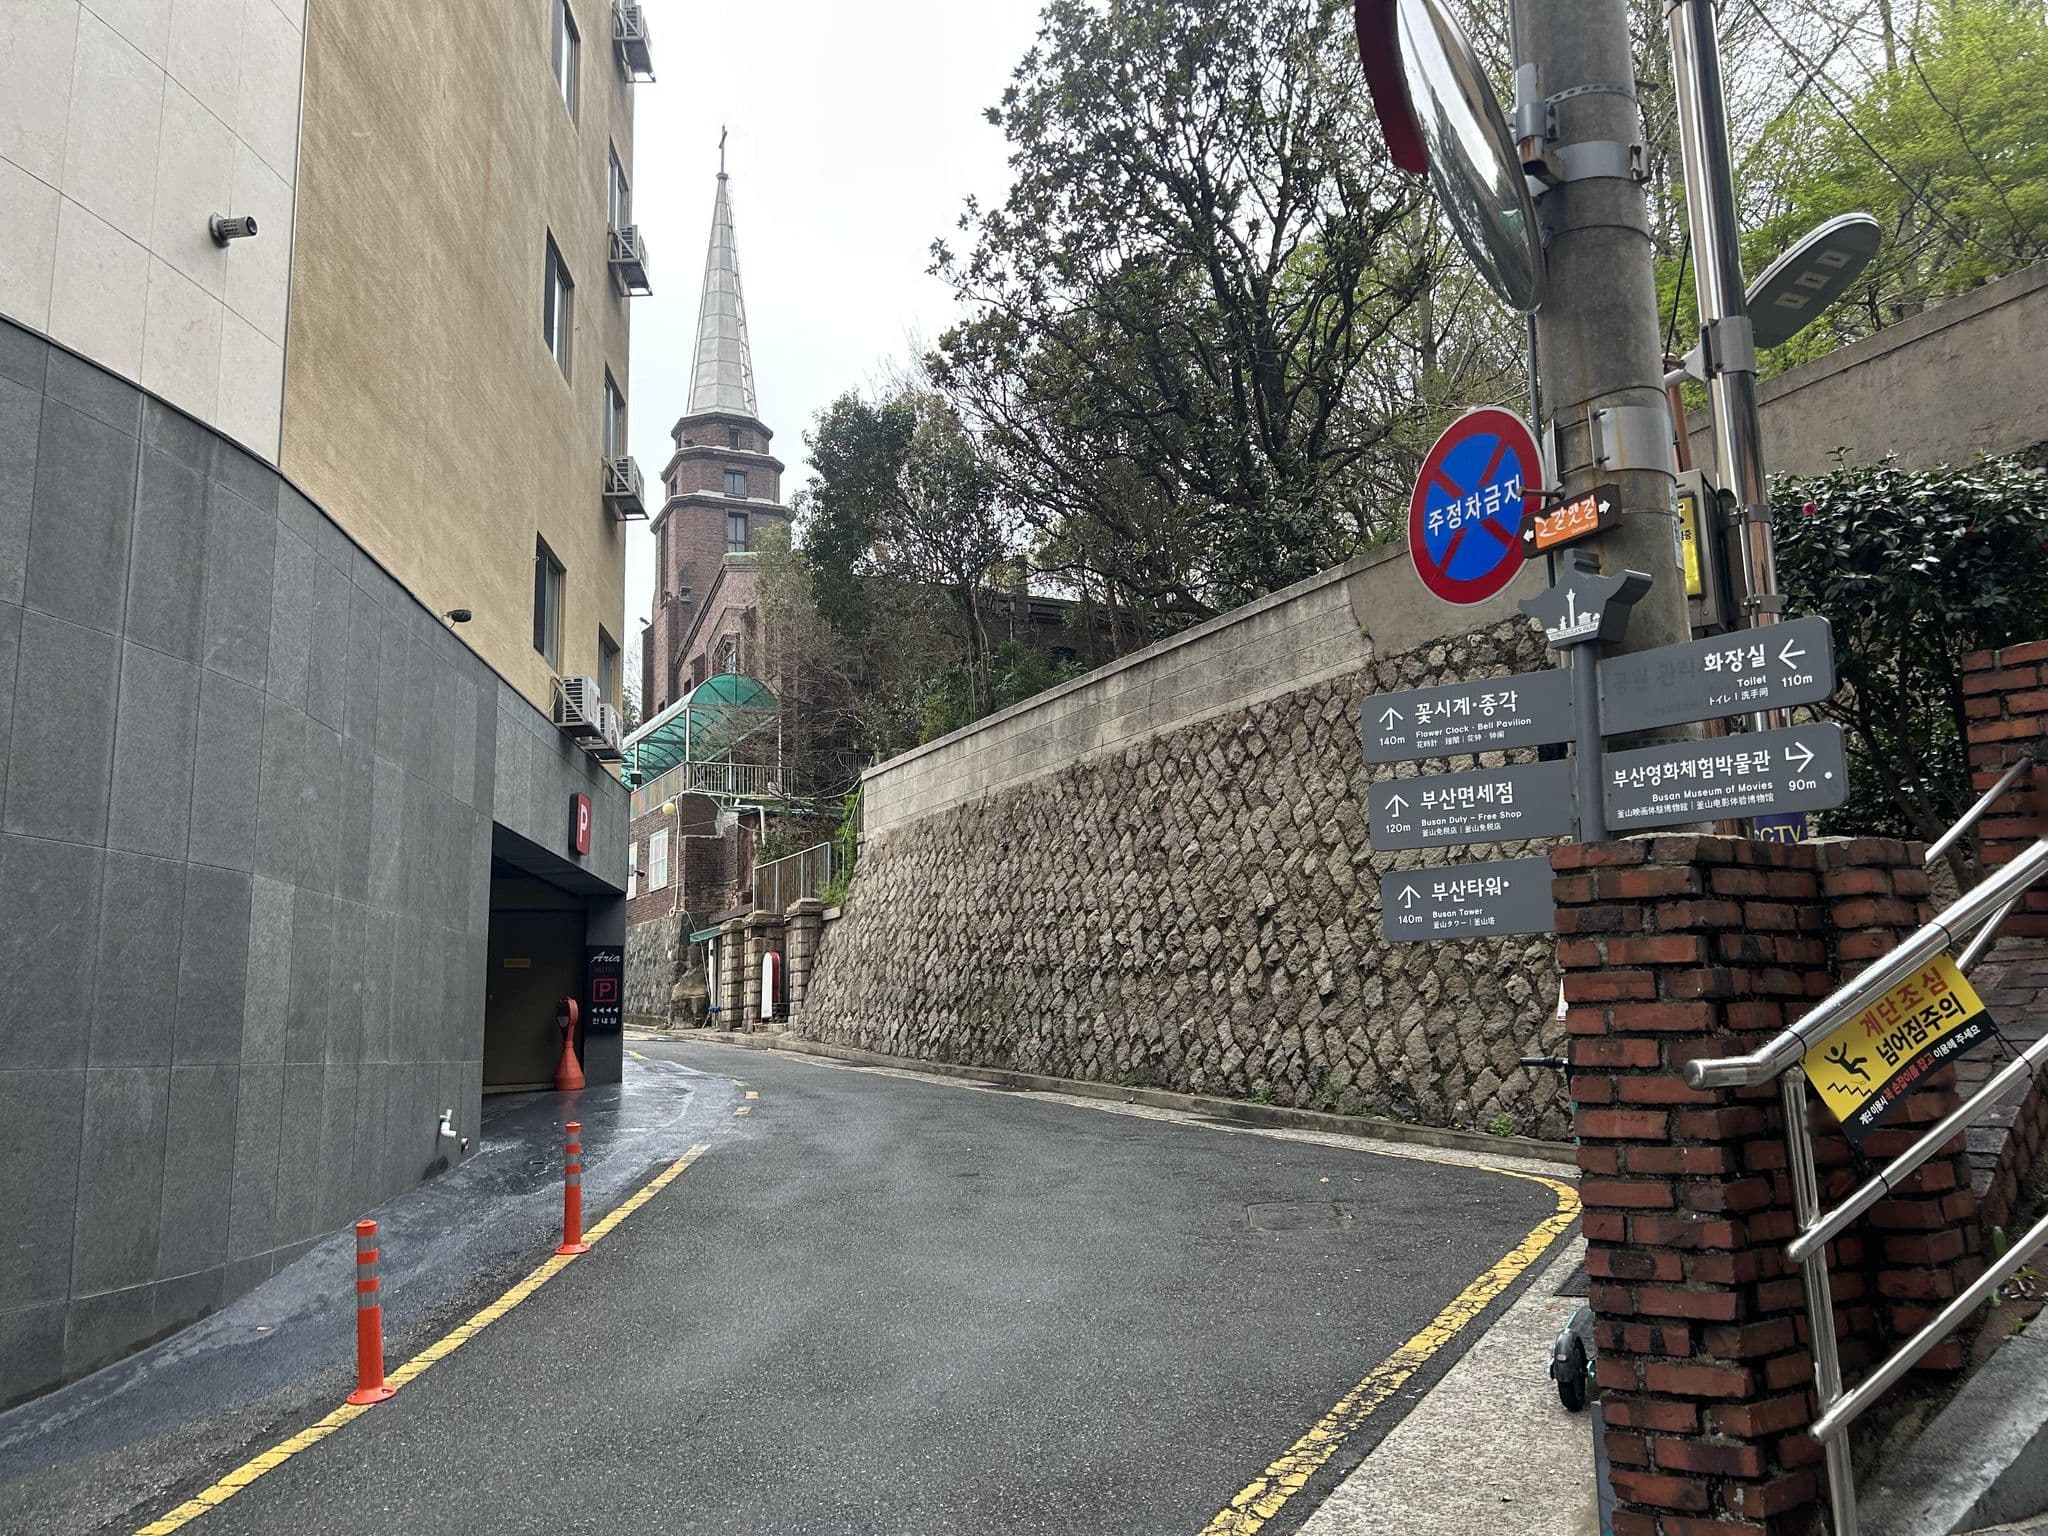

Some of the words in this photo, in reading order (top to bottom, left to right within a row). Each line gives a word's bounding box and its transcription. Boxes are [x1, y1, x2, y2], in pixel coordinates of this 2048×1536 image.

[1428, 474, 1522, 537] 주정차금지
[1704, 643, 1766, 673] 화장실
[1737, 675, 1767, 688] Toilet
[1781, 673, 1813, 689] 110m
[1414, 690, 1518, 725] 꽃시계·종각
[1709, 691, 1731, 706] トイレ
[1415, 729, 1443, 739] Flower
[1445, 725, 1470, 736] Clock
[1477, 722, 1494, 731] Bell
[1496, 717, 1532, 728] Pavilion
[1379, 735, 1406, 747] 140m
[1613, 749, 1771, 788] 부산영화체험박물관
[1420, 781, 1514, 811] 부산면세점
[1652, 792, 1681, 803] Busan
[1683, 787, 1723, 799] Museum
[1725, 785, 1735, 794] of
[1738, 781, 1773, 793] Movies
[1788, 779, 1817, 792] 90m
[579, 804, 588, 843] P
[1385, 823, 1411, 833] 120m
[1421, 818, 1447, 827] Busan
[1449, 815, 1468, 824] Duty
[1478, 813, 1497, 821] Free
[1500, 810, 1522, 819] Shop
[1431, 876, 1502, 902] 부산타워
[1398, 914, 1423, 924] 140m
[1432, 910, 1457, 919] Busan
[1459, 907, 1483, 917] Tower
[590, 950, 621, 964] Aria
[600, 982, 612, 998] P
[1859, 966, 1949, 1038] 계단조심
[1875, 991, 1967, 1067] 넘어짐주의
[1859, 1109, 1874, 1125] 계단
[1870, 1095, 1889, 1114] 이용시
[1892, 1064, 1920, 1095] 손잡이를
[1916, 1052, 1936, 1072] 잡고
[1933, 1037, 1958, 1058] 이용해
[1954, 1025, 1981, 1045] 주세요
